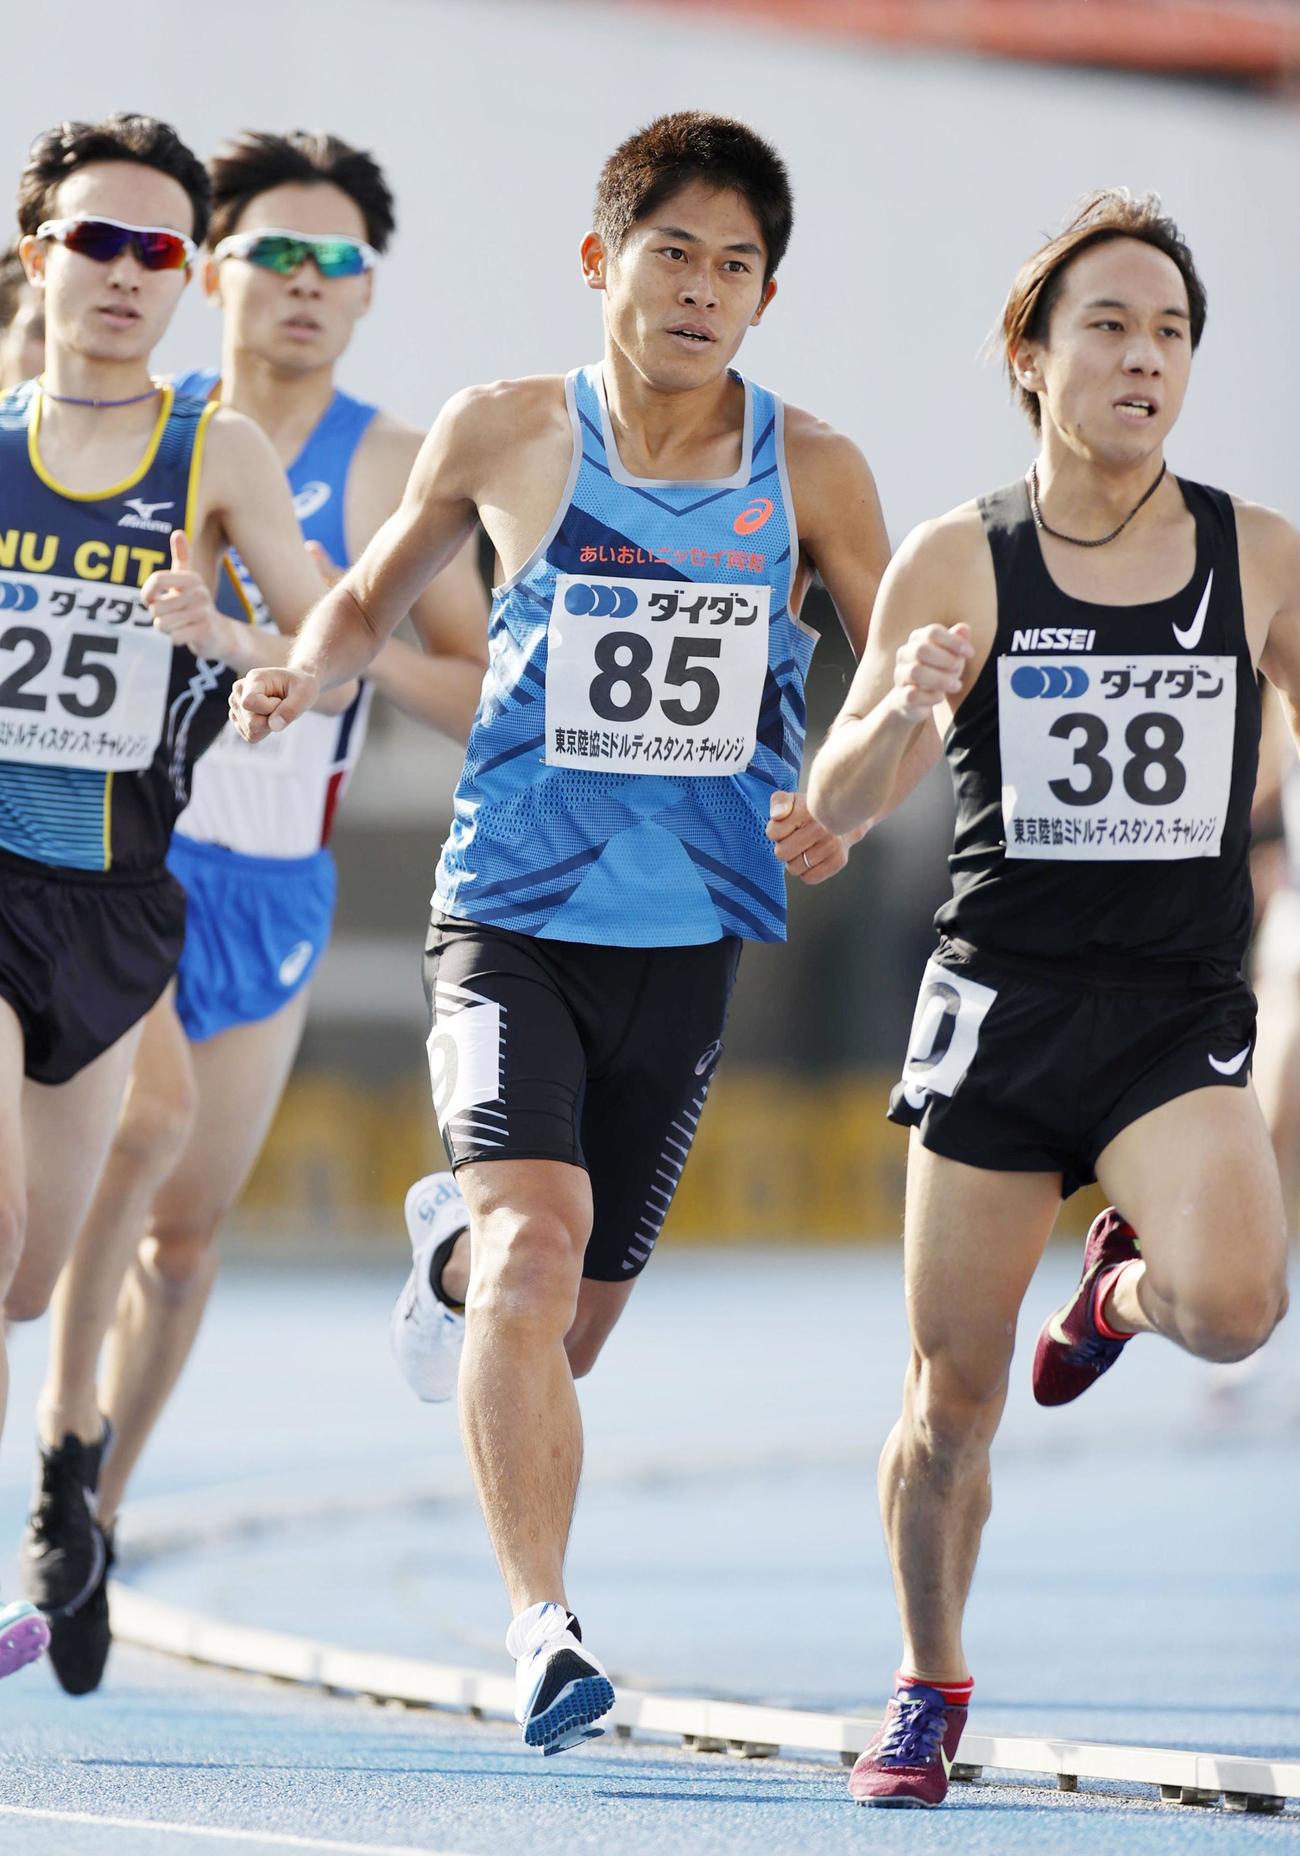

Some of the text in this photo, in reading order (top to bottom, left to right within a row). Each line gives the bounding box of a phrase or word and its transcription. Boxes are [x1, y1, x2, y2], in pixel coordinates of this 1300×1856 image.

[648, 589, 758, 626] ダイダン
[1011, 627, 1096, 652] NISSEI
[0, 626, 119, 718] 25
[589, 631, 722, 726] 85
[1099, 664, 1224, 700] ダイダン
[1048, 711, 1187, 806] 38
